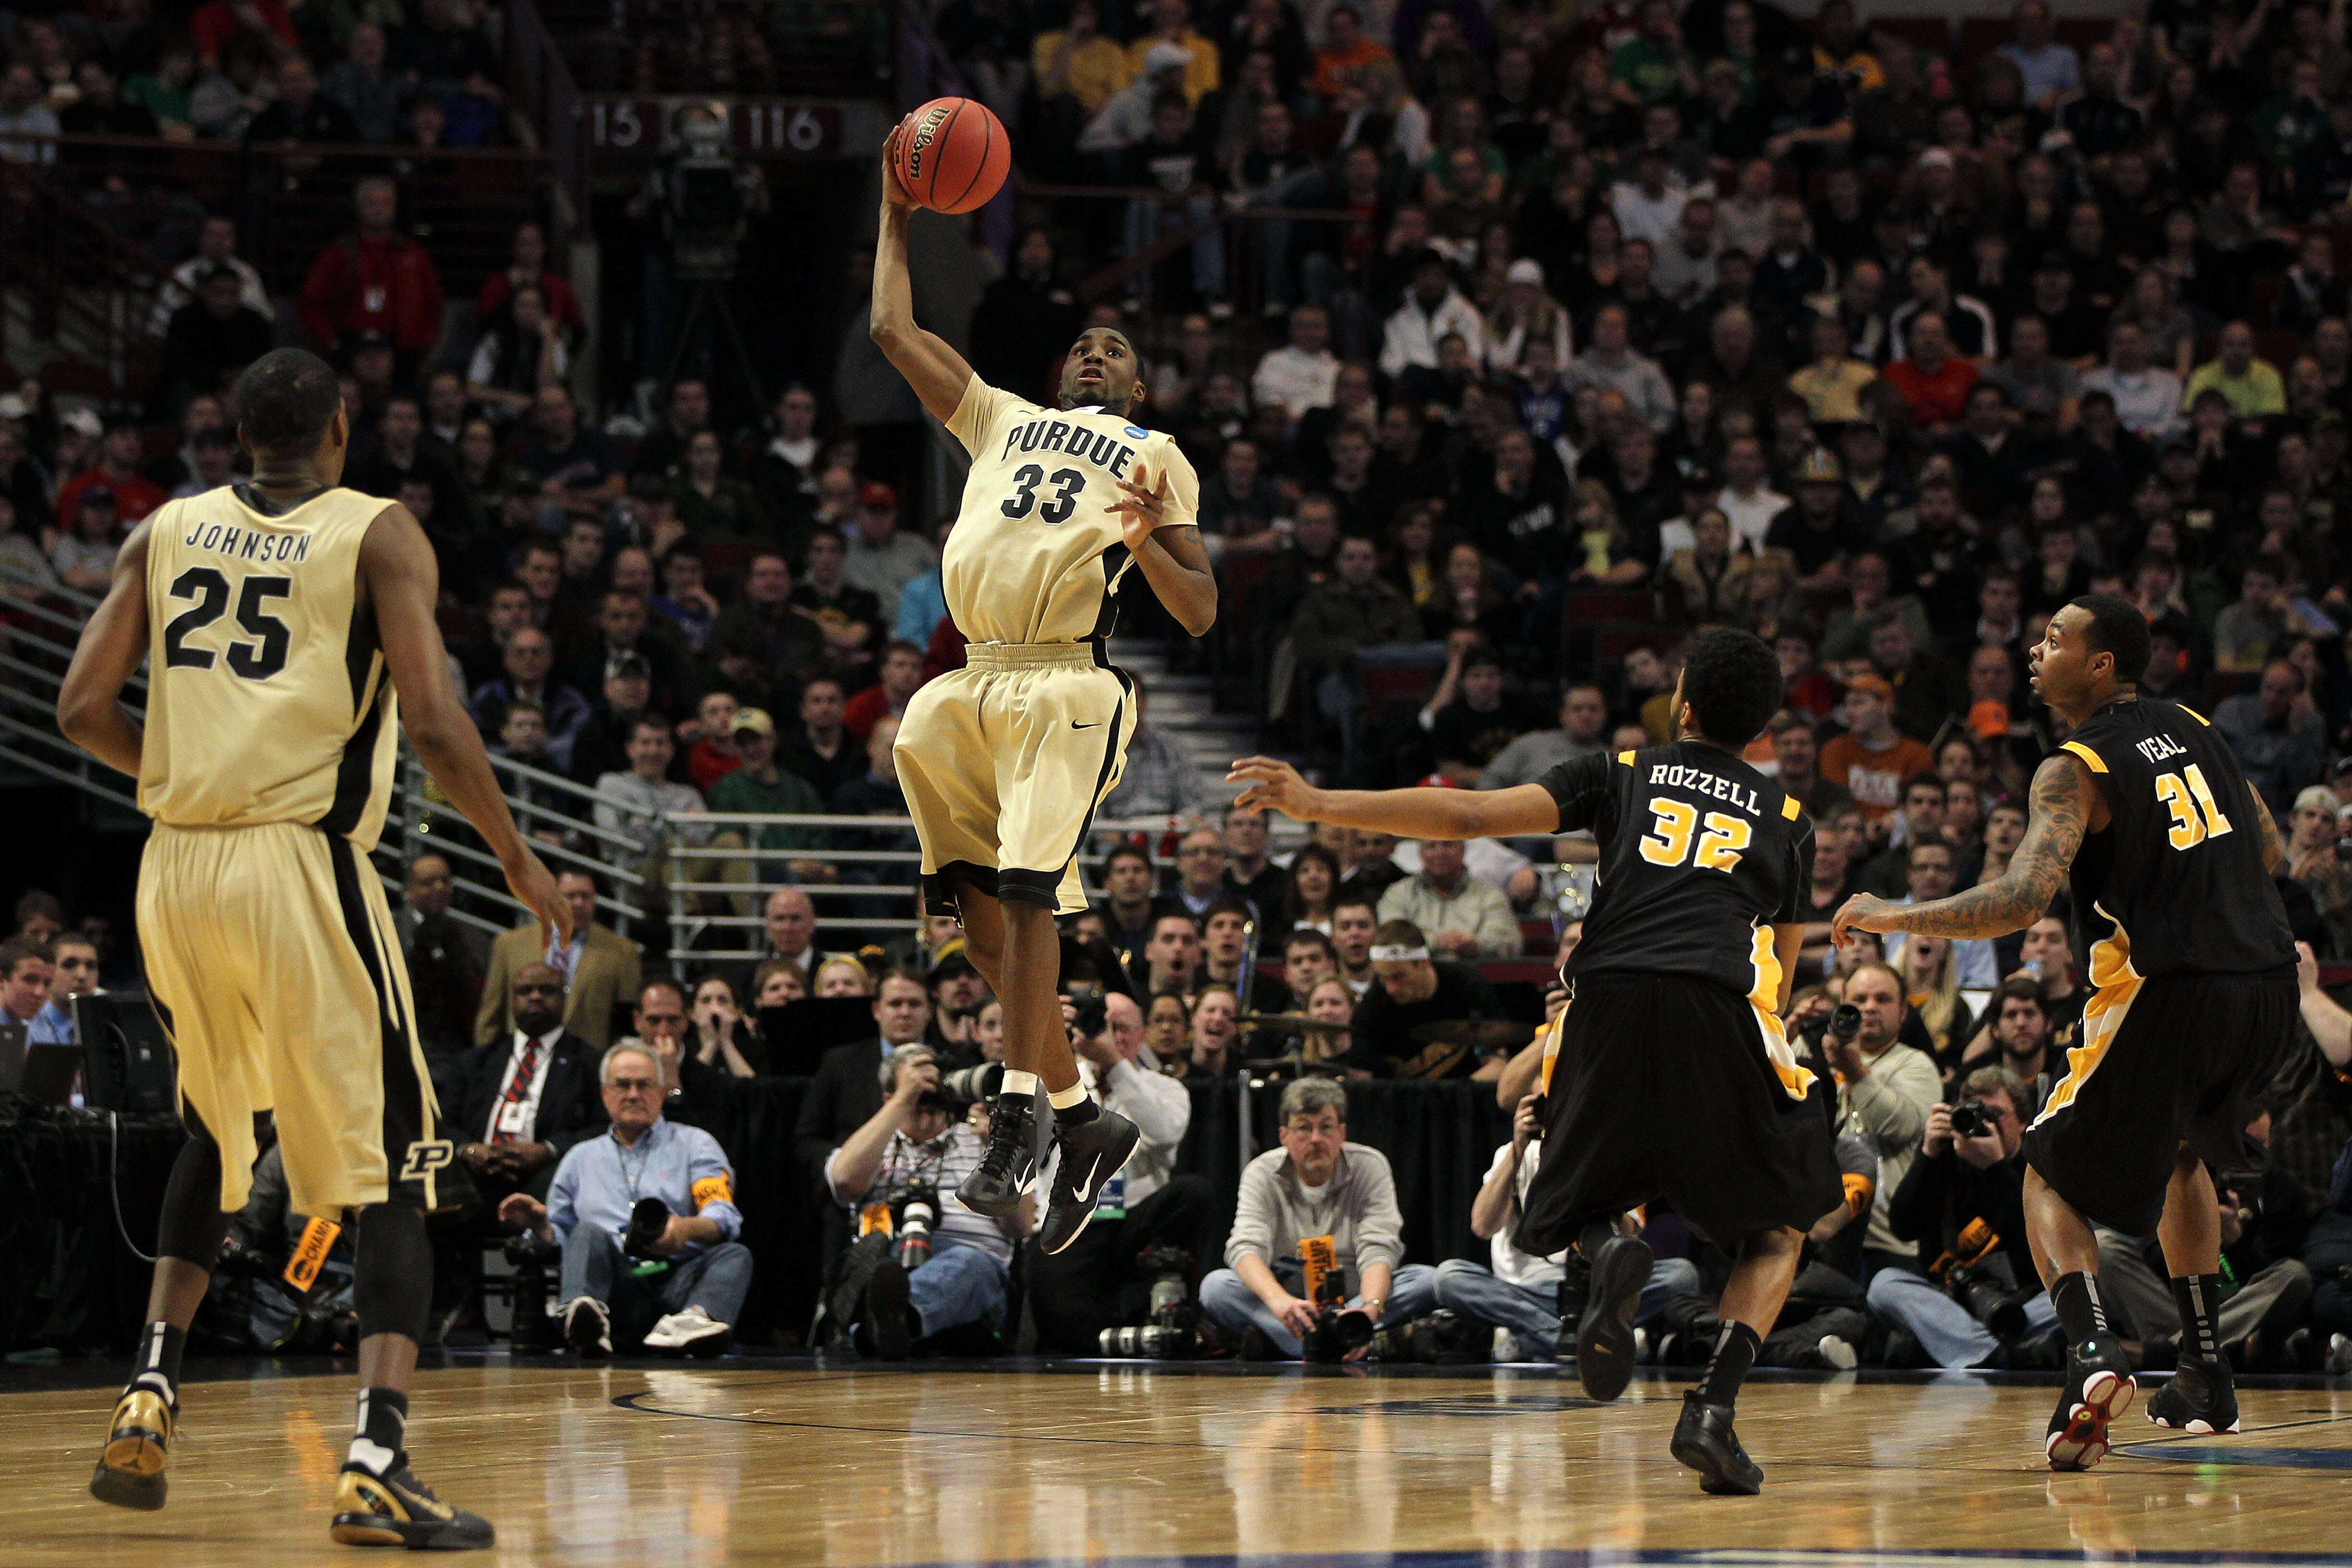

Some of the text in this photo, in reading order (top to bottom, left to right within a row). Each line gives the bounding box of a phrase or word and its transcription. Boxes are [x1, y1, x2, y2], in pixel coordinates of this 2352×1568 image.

[571, 103, 643, 147] 15
[750, 105, 823, 151] 116
[909, 107, 953, 179] Wilson
[1000, 419, 1137, 480] PURDUE
[999, 463, 1088, 525] 33
[186, 521, 312, 563] JOHNSON
[164, 565, 294, 683] 25
[2135, 733, 2187, 764] VEAL
[1648, 764, 1761, 817] ROZZELL
[2155, 763, 2233, 851] 31
[1638, 796, 1752, 874] 32
